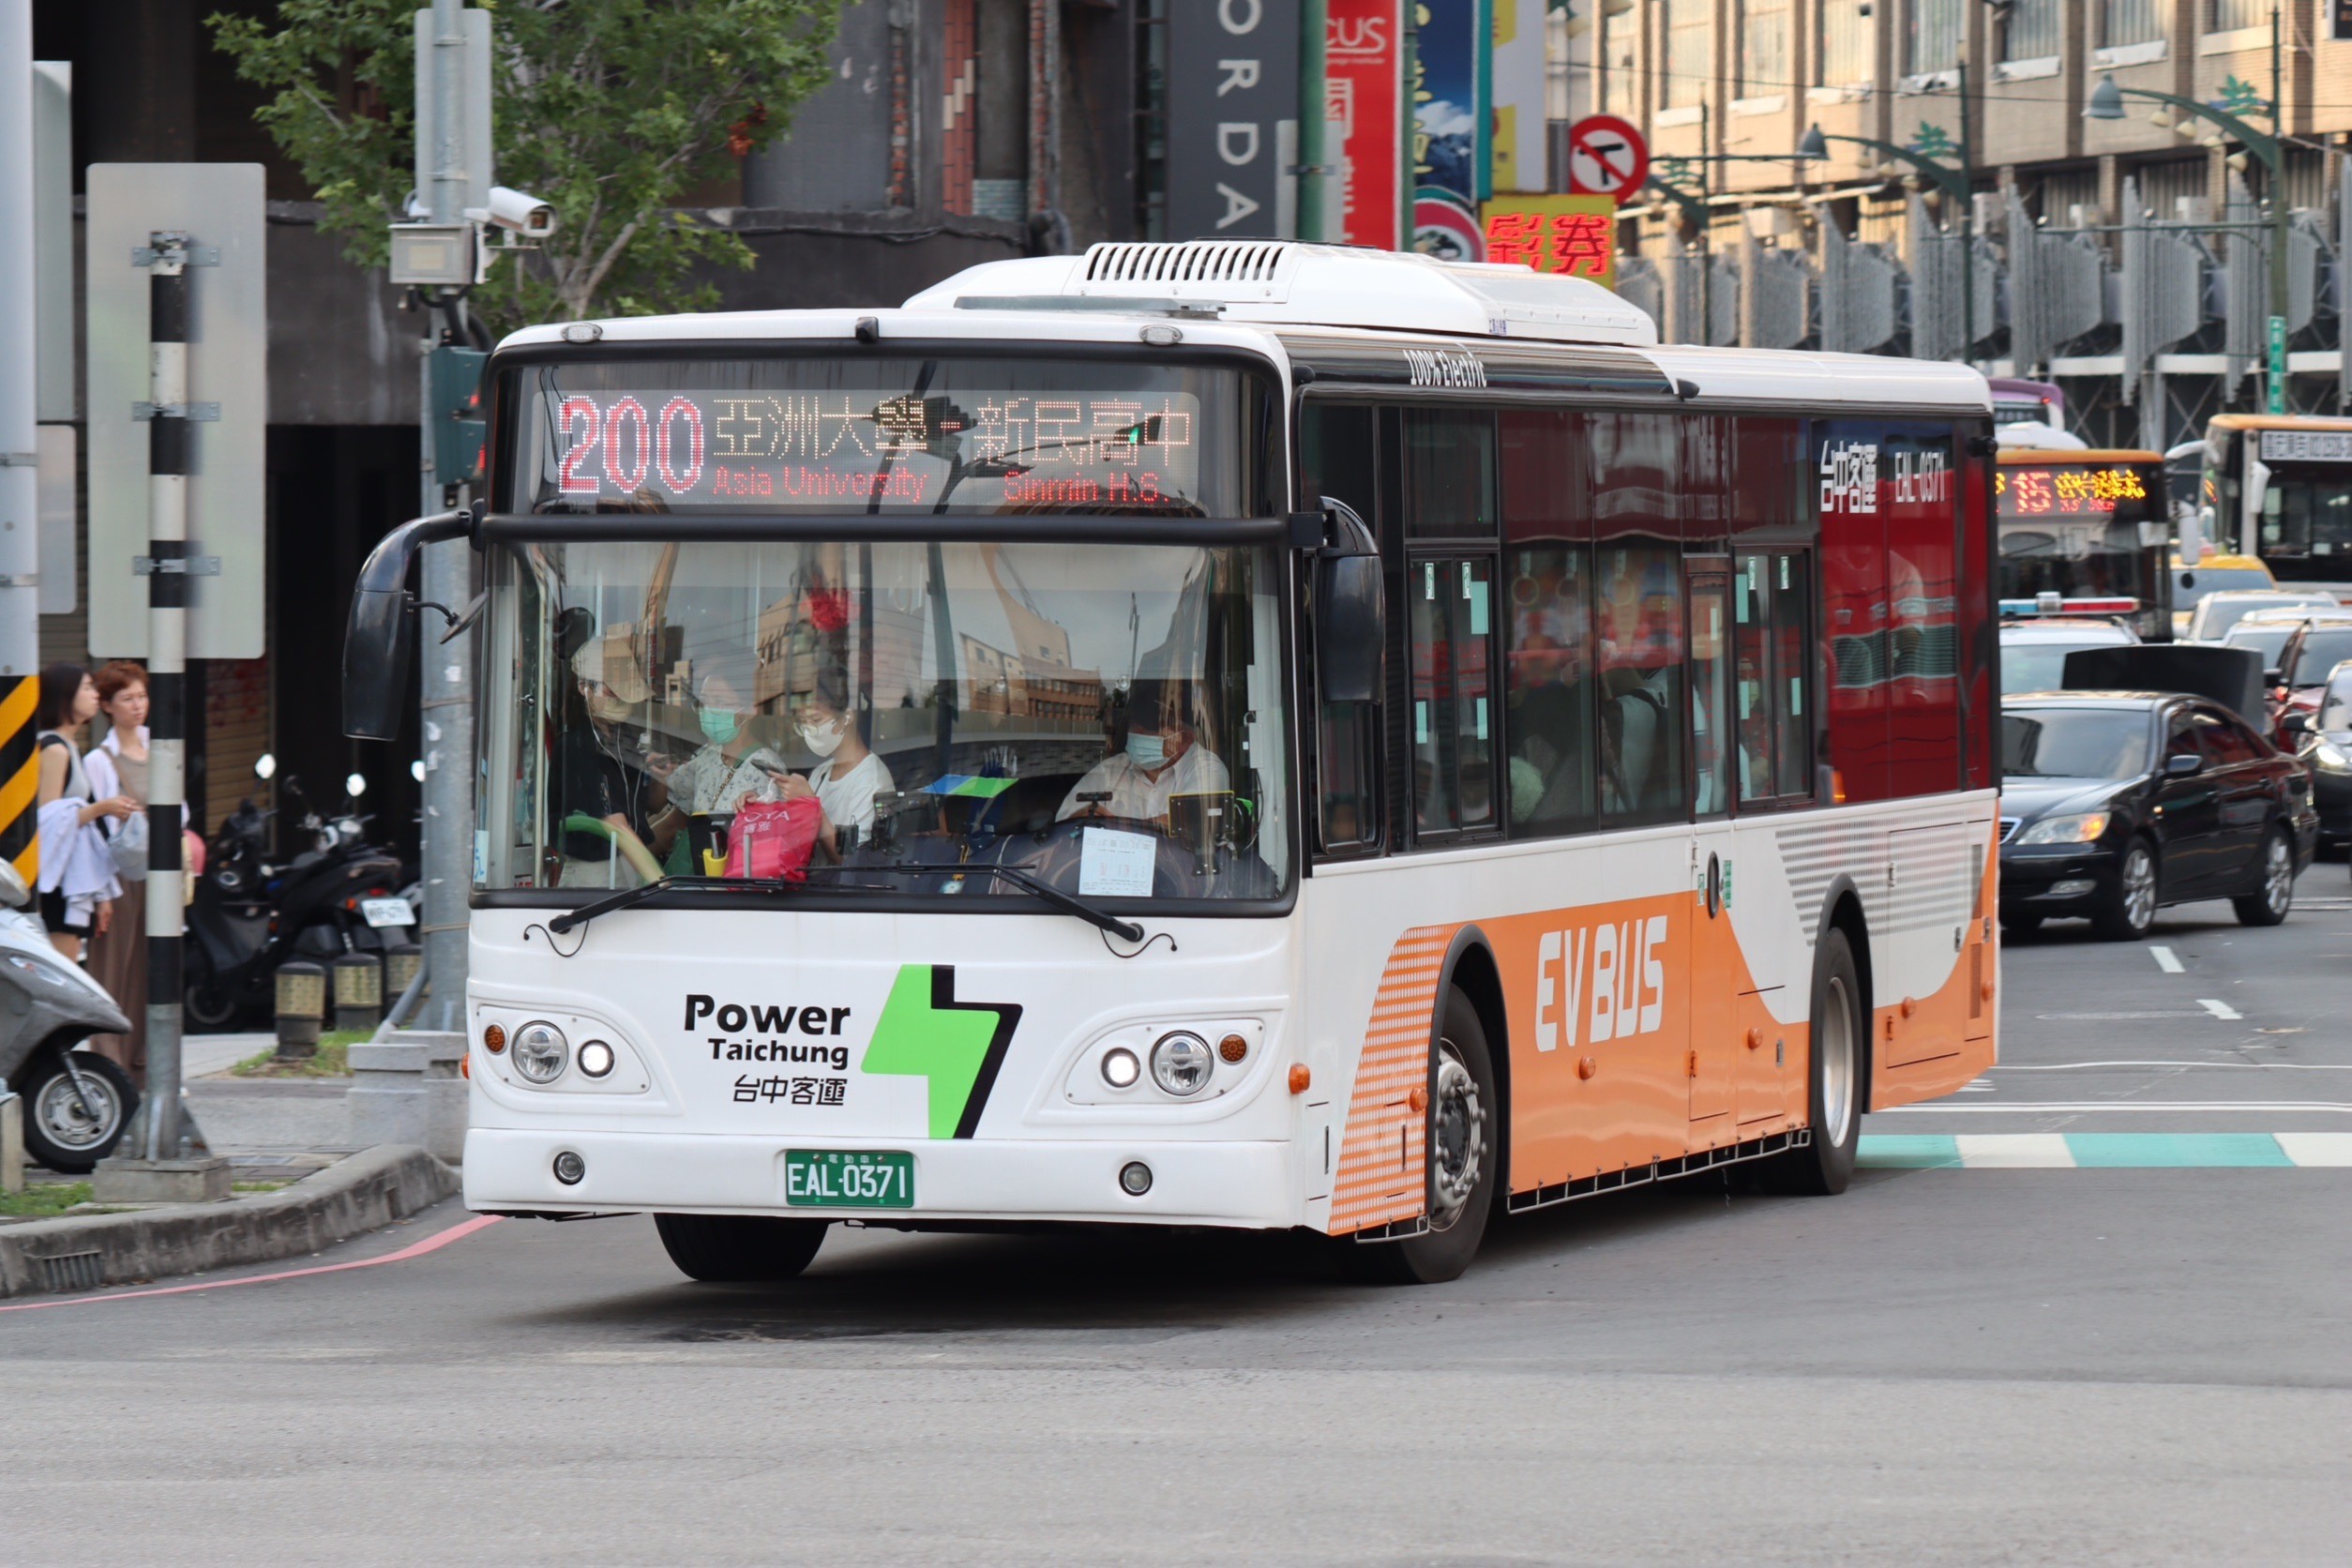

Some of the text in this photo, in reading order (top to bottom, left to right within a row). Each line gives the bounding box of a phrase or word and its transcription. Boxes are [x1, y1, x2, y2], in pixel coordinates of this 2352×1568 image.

[1486, 212, 1611, 275] 彩券
[1403, 350, 1487, 387] 100% Electric
[559, 396, 703, 493] 200
[714, 467, 1170, 502] Asia University Sinmin H.S.
[1820, 441, 1945, 514] 台中客運 EAL-0371
[684, 994, 851, 1035] Power
[708, 1038, 849, 1070] Taichung
[732, 1074, 848, 1106] 台中客運
[788, 1163, 906, 1199] EAL-0371
